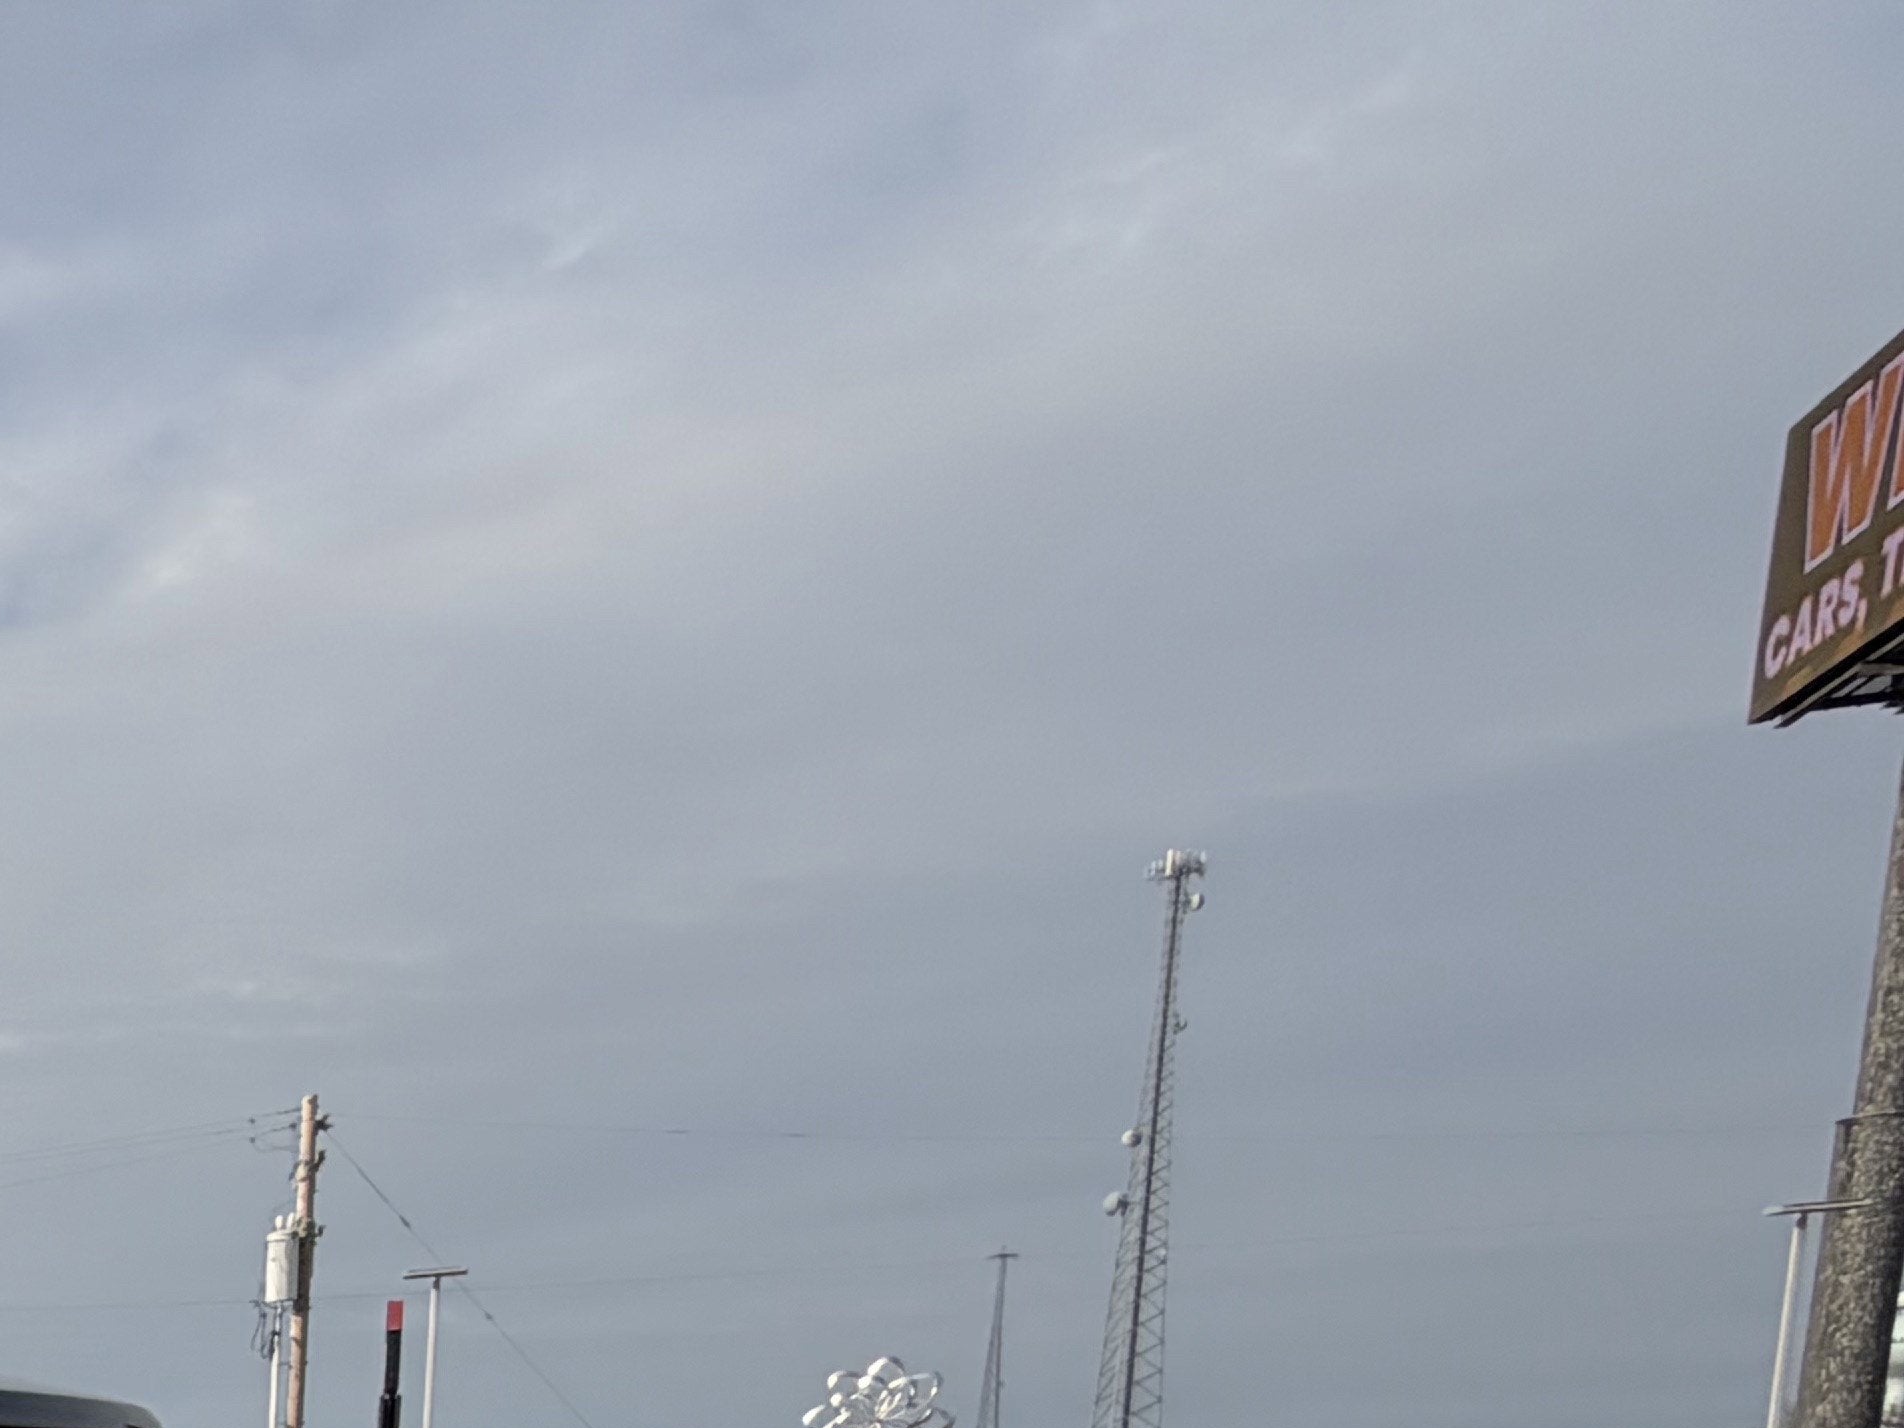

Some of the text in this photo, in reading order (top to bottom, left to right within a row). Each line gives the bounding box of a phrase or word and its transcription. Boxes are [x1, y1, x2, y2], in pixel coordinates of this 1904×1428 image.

[1803, 351, 1904, 575] W
[1764, 526, 1904, 680] CARS, T
